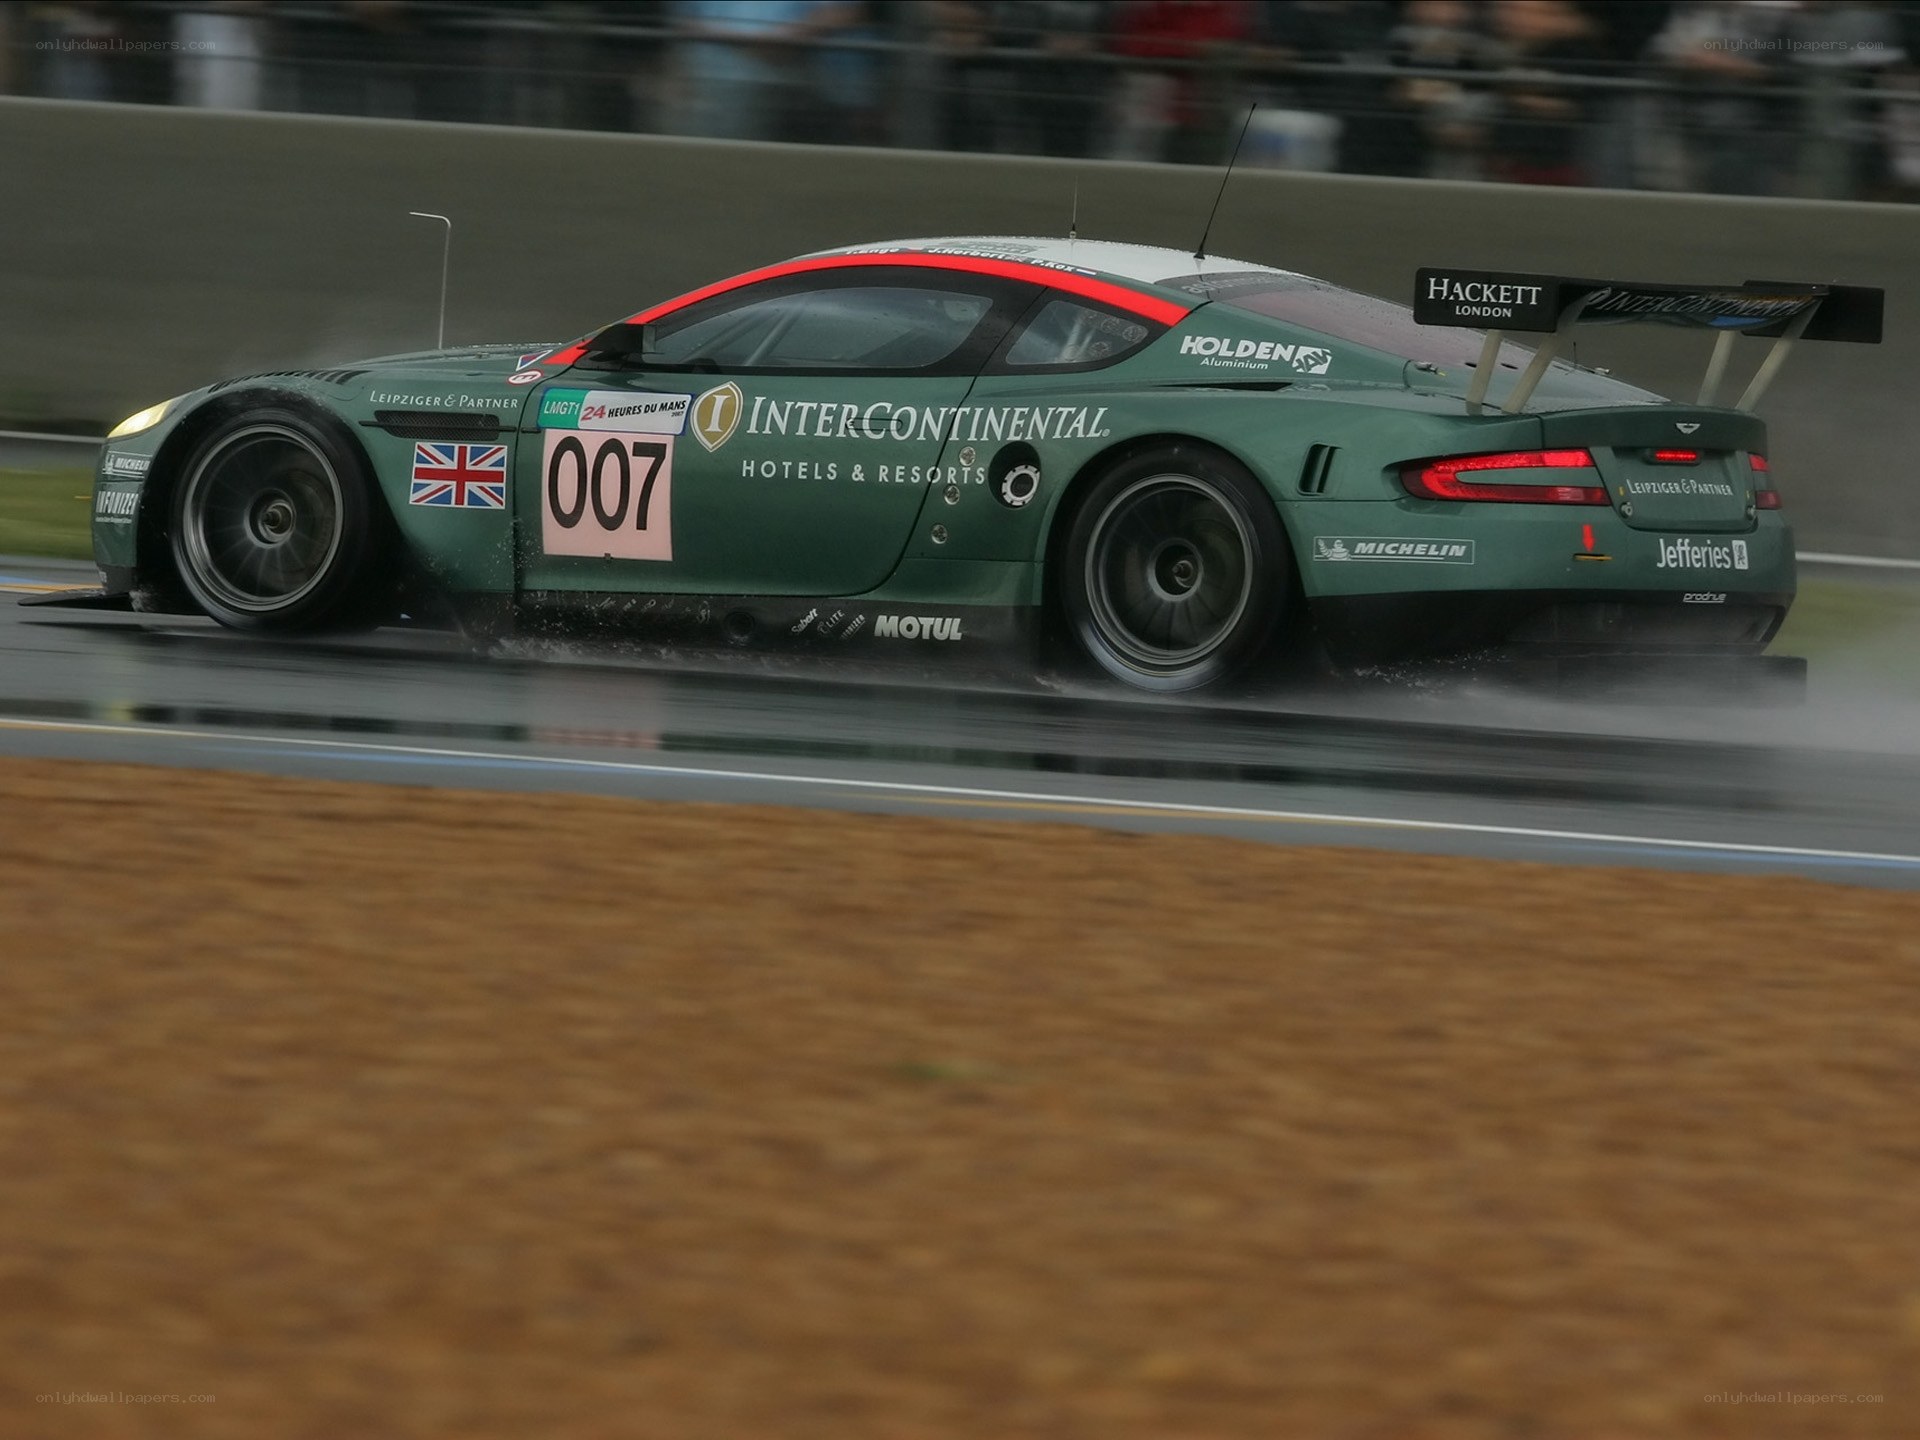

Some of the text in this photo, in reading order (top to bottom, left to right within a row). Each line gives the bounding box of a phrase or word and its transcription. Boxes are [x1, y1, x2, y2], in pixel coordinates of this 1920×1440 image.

[1031, 259, 1074, 272] P.Kox
[1428, 277, 1542, 305] HACKETT
[1456, 305, 1512, 318] LONDON
[1180, 335, 1295, 362] HOLDEN
[1200, 356, 1269, 370] Aluminium
[370, 390, 518, 409] LEIPZIGER & PARTNER
[543, 401, 581, 415] LMGT1
[581, 400, 686, 421] 24 HEURES DU MANS
[742, 460, 985, 484] HOTELS & RESORTS
[548, 435, 667, 532] 007
[1626, 479, 1734, 496] LEIPZIGER & PARTNER
[1354, 542, 1467, 557] MICHELIN
[1657, 538, 1732, 569] Jefferies
[874, 615, 962, 640] MOTUL
